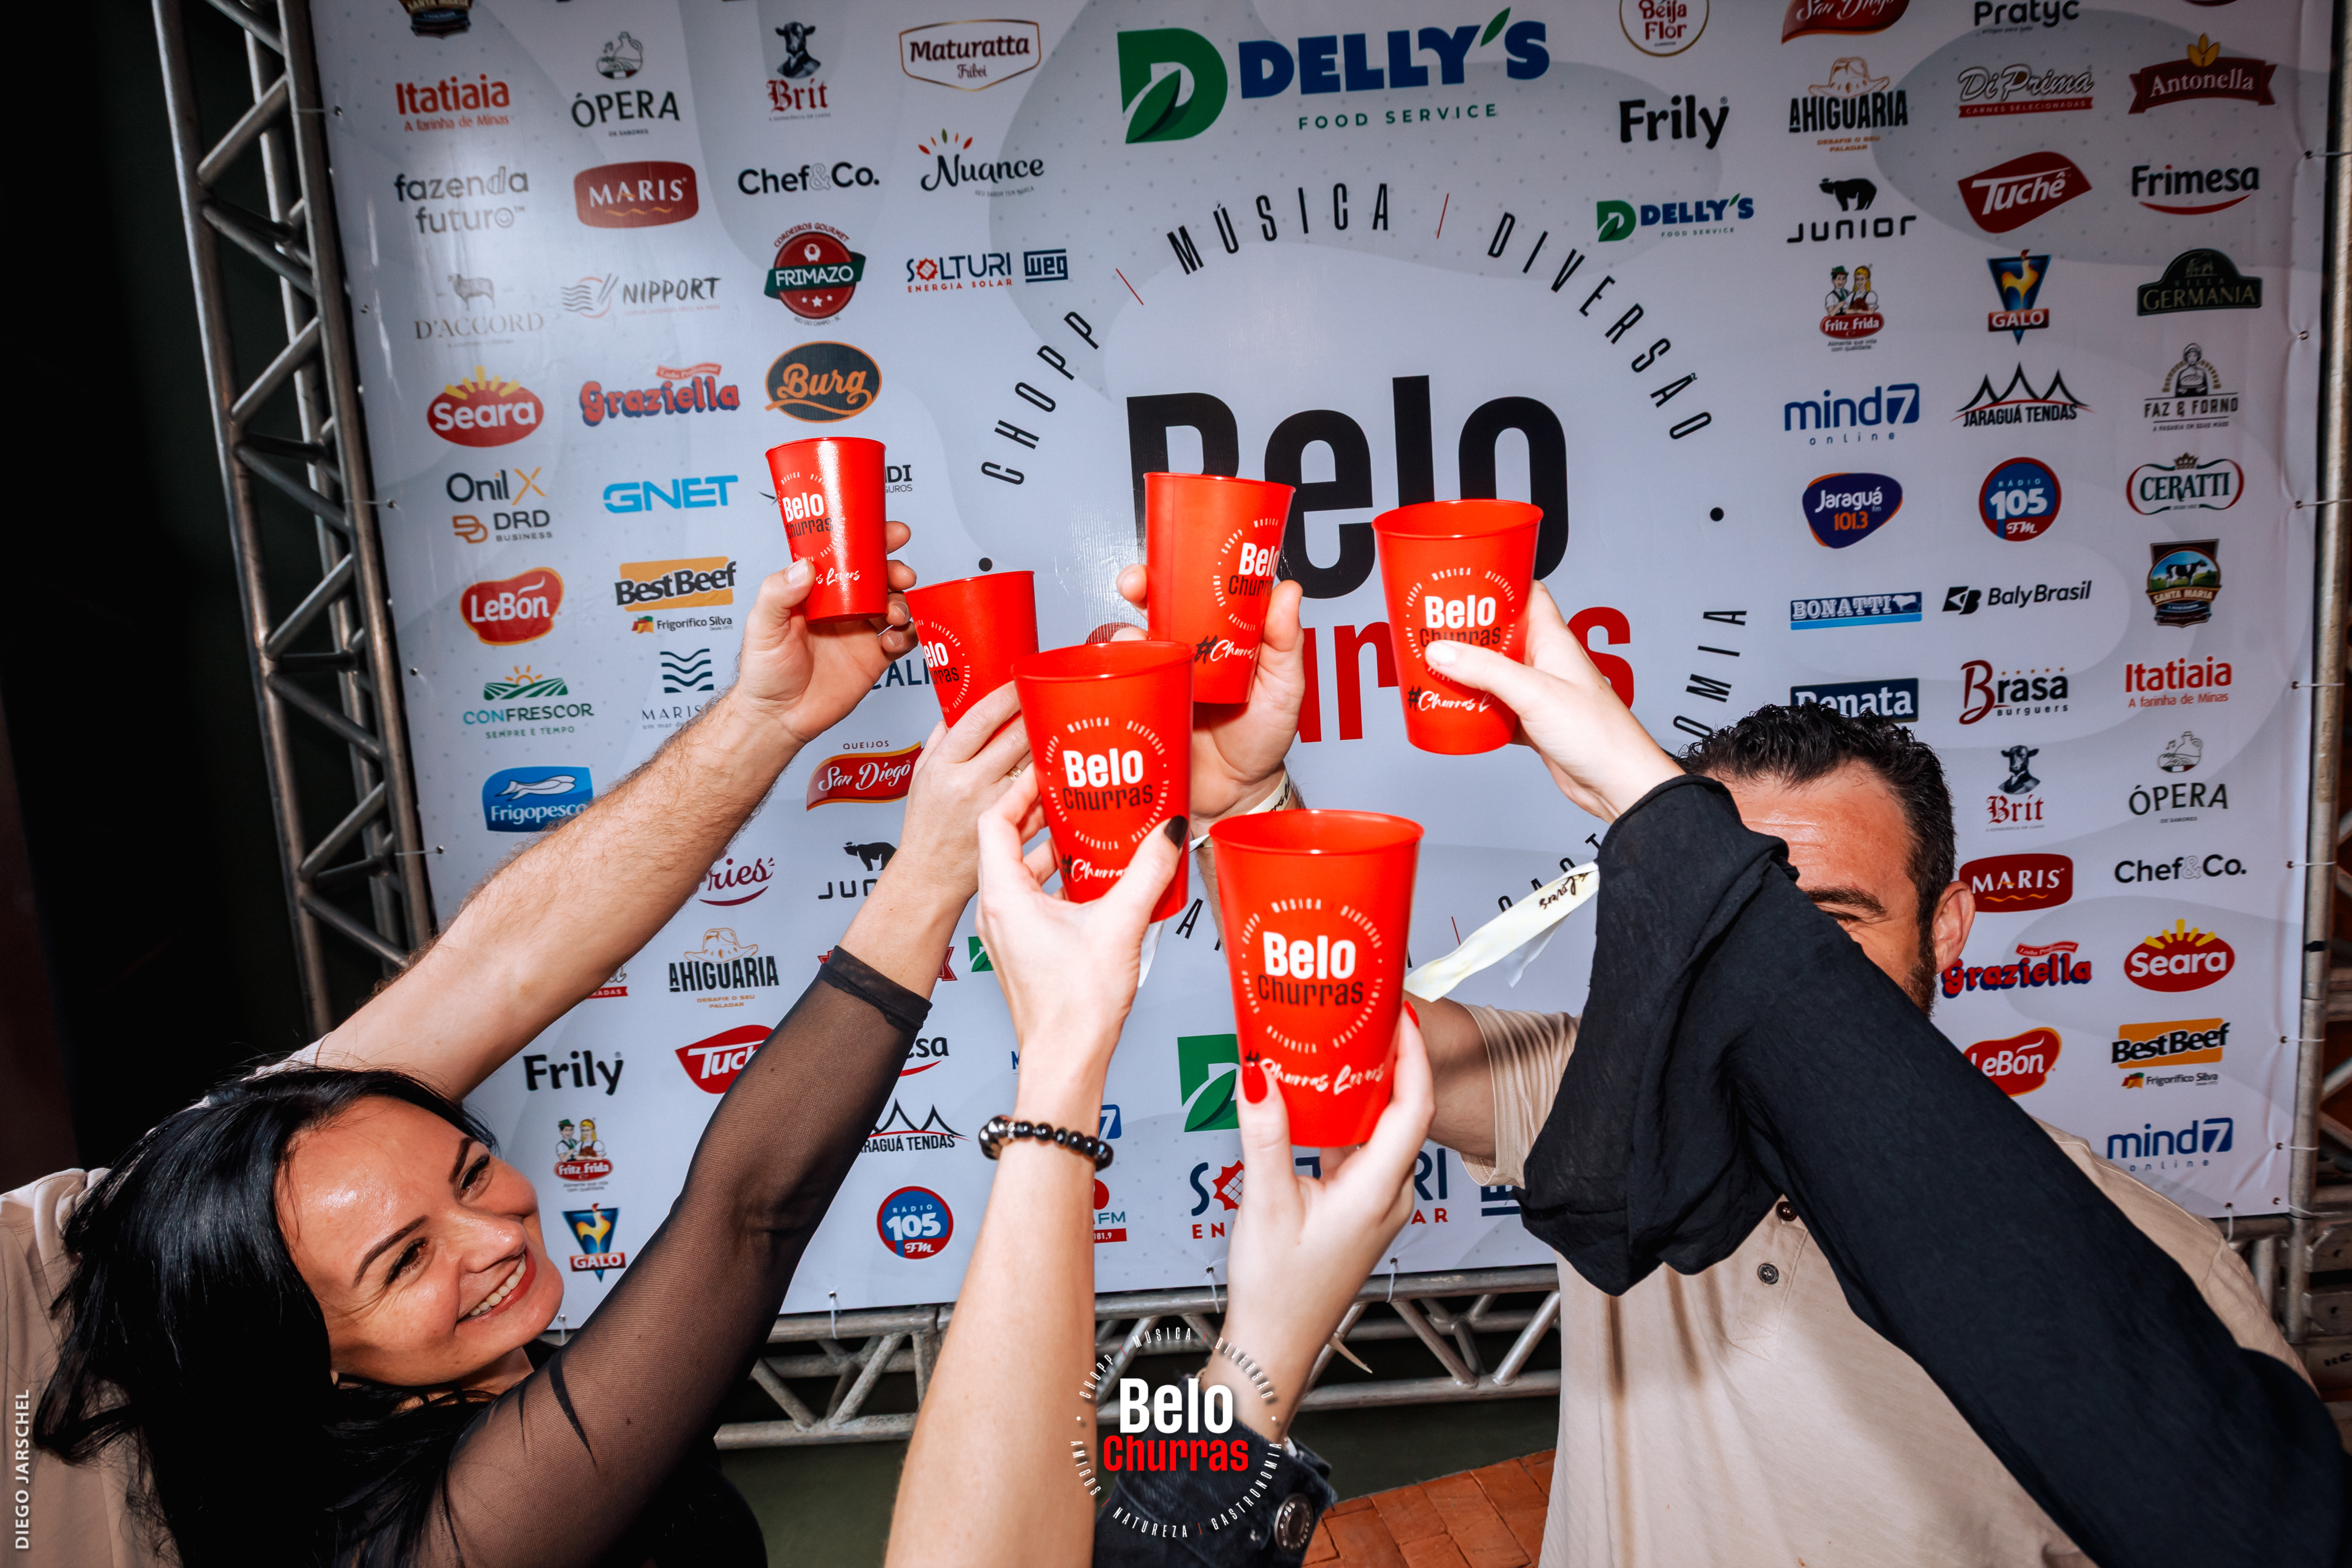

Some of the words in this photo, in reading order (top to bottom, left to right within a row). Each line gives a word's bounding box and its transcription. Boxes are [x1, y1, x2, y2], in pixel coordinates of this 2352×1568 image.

[1975, 0, 2080, 27] Pratyc
[1645, 21, 1687, 41] Flor
[910, 34, 1030, 62] Maturatta
[1238, 7, 1550, 99] DELLY'S
[395, 73, 510, 115] Itatiaia
[2149, 69, 2254, 98] Antonella
[571, 90, 680, 128] ÓPERA
[1298, 113, 1368, 131] FOOD
[1386, 103, 1497, 125] SERVICE
[1789, 90, 1909, 133] AHIGUARIA
[395, 167, 529, 202] fazenda
[921, 153, 1044, 192] Nuance
[2132, 164, 2260, 198] Frimesa
[589, 179, 683, 208] MARIS
[1641, 193, 1755, 226] DELLY'S
[1693, 227, 1735, 236] SERVICE
[775, 265, 854, 287] FRIMAZO
[908, 281, 964, 293] ENERGIA
[972, 279, 1013, 289] SOLAR
[623, 277, 721, 305] NIPPORT
[2142, 284, 2256, 311] GERMANIA
[414, 312, 544, 340] D'ACCORD
[1825, 319, 1849, 332] Fritz
[1853, 316, 1880, 330] Frida
[1991, 310, 2044, 329] GALO
[775, 363, 872, 410] Burg
[981, 311, 1099, 485] CHOPP
[433, 399, 536, 432] Seara
[579, 376, 740, 427] Graziella
[1963, 404, 2022, 427] JARAGUÁ
[2026, 403, 2078, 423] TENDAS
[2144, 402, 2170, 418] FAZ
[2191, 397, 2239, 415] FORNO
[603, 475, 739, 513] GNET
[1998, 478, 2041, 487] RÁDIO
[2140, 472, 2231, 502] CERATTI
[782, 492, 824, 523] Belo
[1815, 486, 1883, 513] Jaraguá
[1990, 488, 2048, 520] 105
[495, 510, 551, 530] DRD
[786, 517, 834, 540] Churras
[1834, 513, 1869, 530] 101.3
[496, 531, 553, 542] BUSINESS
[1792, 595, 1893, 619] BONATTI
[2153, 590, 2181, 604] SANTA
[2183, 589, 2214, 600] MARIA
[709, 616, 733, 626] Silva
[1424, 594, 1496, 629] Belo
[923, 640, 949, 668] elo
[2125, 656, 2233, 693] Itatiaia
[1959, 659, 2069, 725] Brasa
[2128, 698, 2137, 708] A
[2140, 694, 2177, 708] farinha
[2181, 694, 2194, 706] de
[2197, 691, 2229, 704] Minas
[463, 703, 594, 726] CONFRESCOR
[1996, 705, 2069, 717] Burguers
[485, 728, 526, 739] SEMPRE
[540, 726, 575, 735] TEMPO
[843, 739, 890, 750] QUEIJOS
[818, 764, 853, 793] San
[856, 760, 912, 791] Diego
[1063, 748, 1144, 788] Belo
[1063, 784, 1154, 811] Churras
[2128, 781, 2229, 816] ÓPERA
[1972, 868, 2060, 895] MARIS
[1262, 931, 1357, 980] Belo
[2130, 950, 2228, 978] Seara
[669, 955, 780, 993] AHIGUARIA
[1940, 953, 2092, 999] Graziella
[1258, 974, 1364, 1007] Churras
[2196, 1072, 2219, 1082] Silva
[906, 1134, 956, 1152] TENDAS
[893, 1203, 933, 1213] RÁDIO
[1098, 1211, 1127, 1225] FM
[886, 1211, 941, 1242] 105
[573, 1254, 622, 1269] GALO
